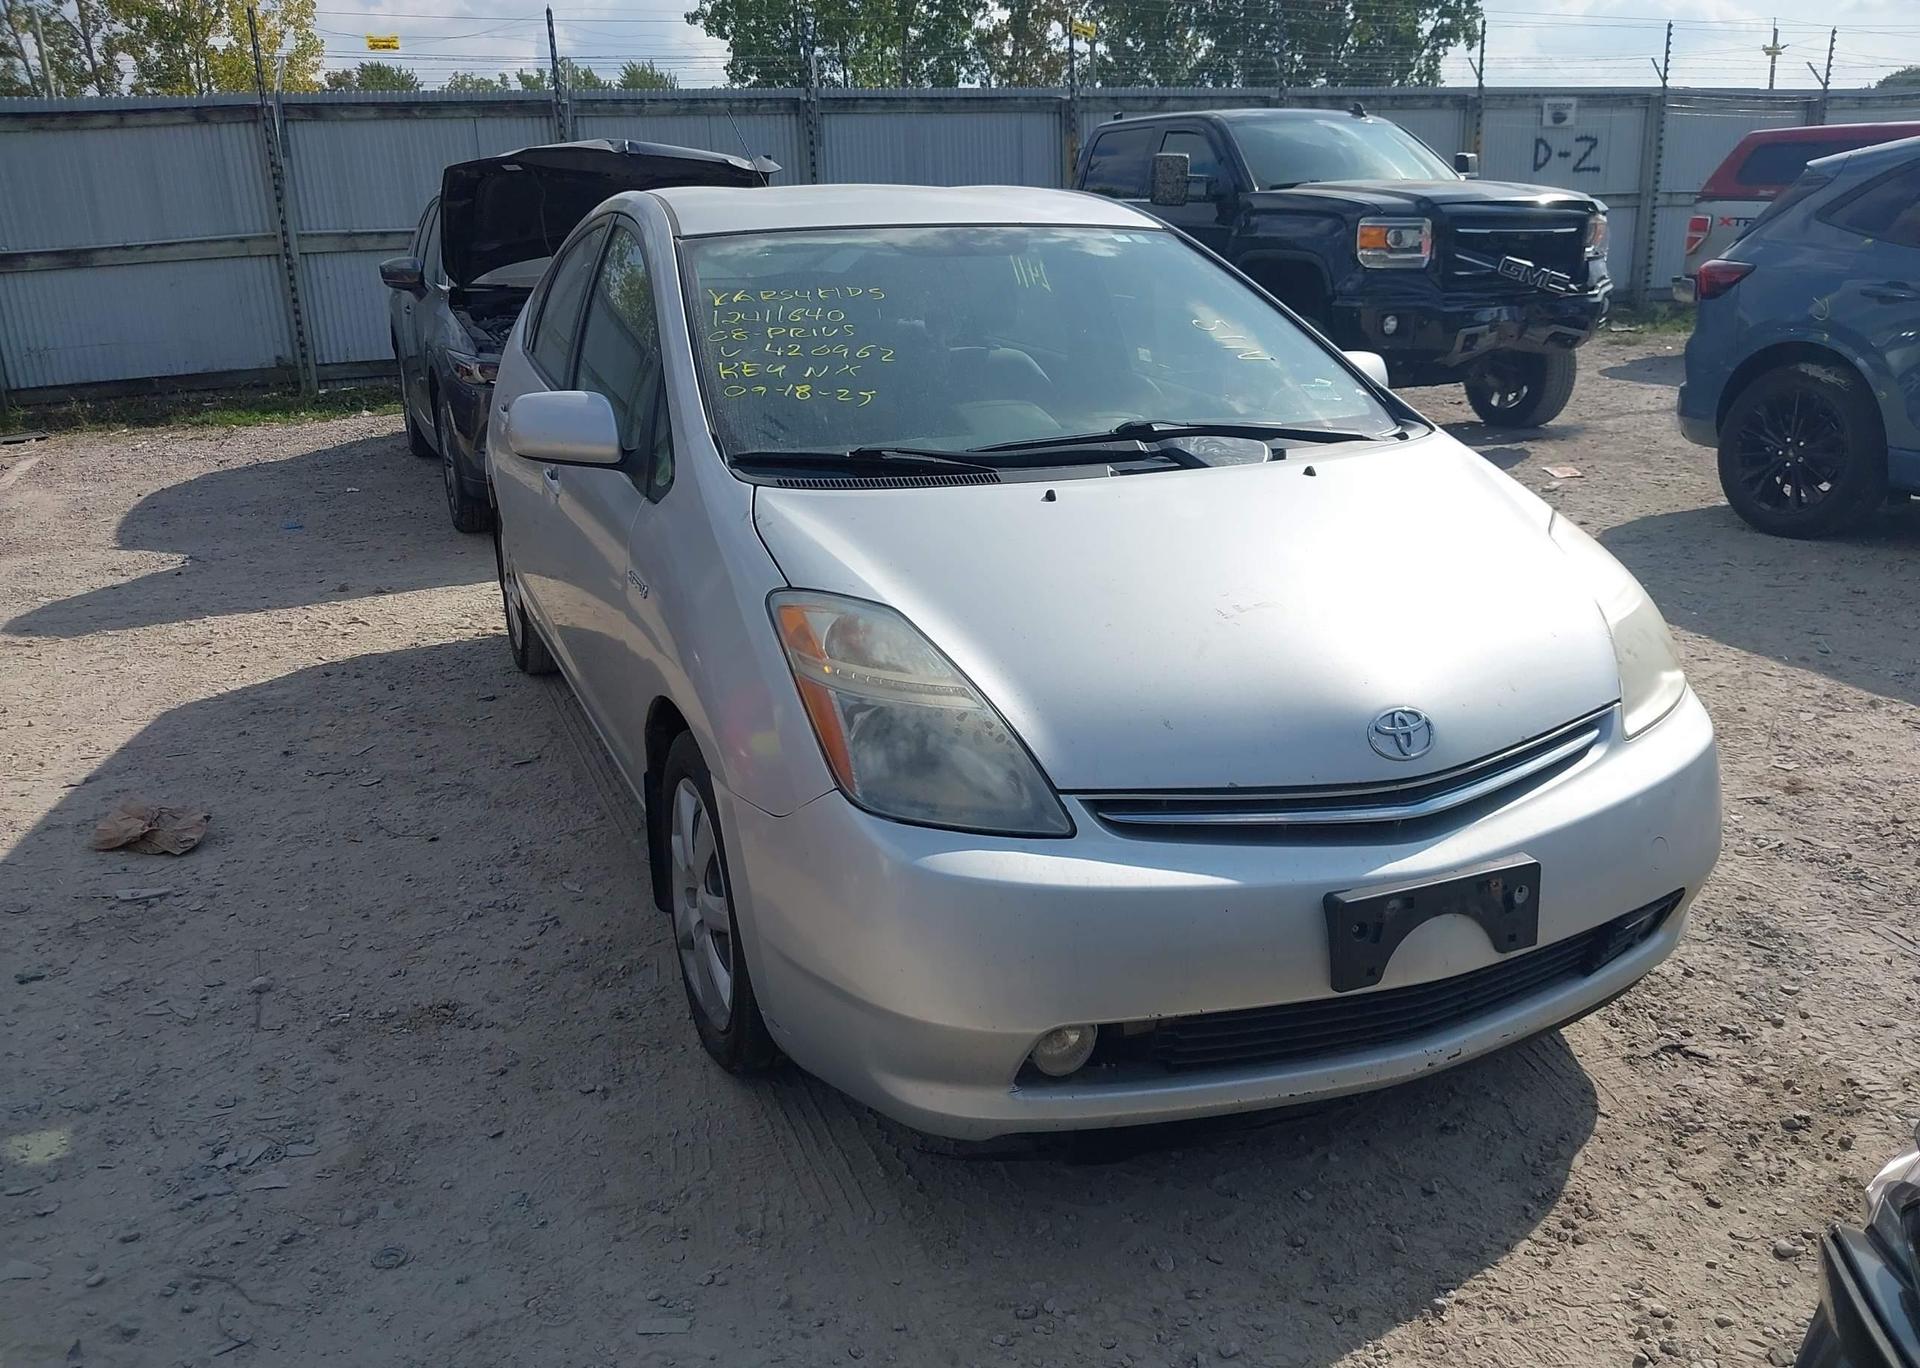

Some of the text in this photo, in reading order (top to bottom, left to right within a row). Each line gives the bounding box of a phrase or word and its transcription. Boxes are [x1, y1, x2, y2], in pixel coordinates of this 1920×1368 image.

[1498, 256, 1576, 296] GMC
[719, 361, 786, 380] KEY
[724, 384, 877, 407] 09-18-25
